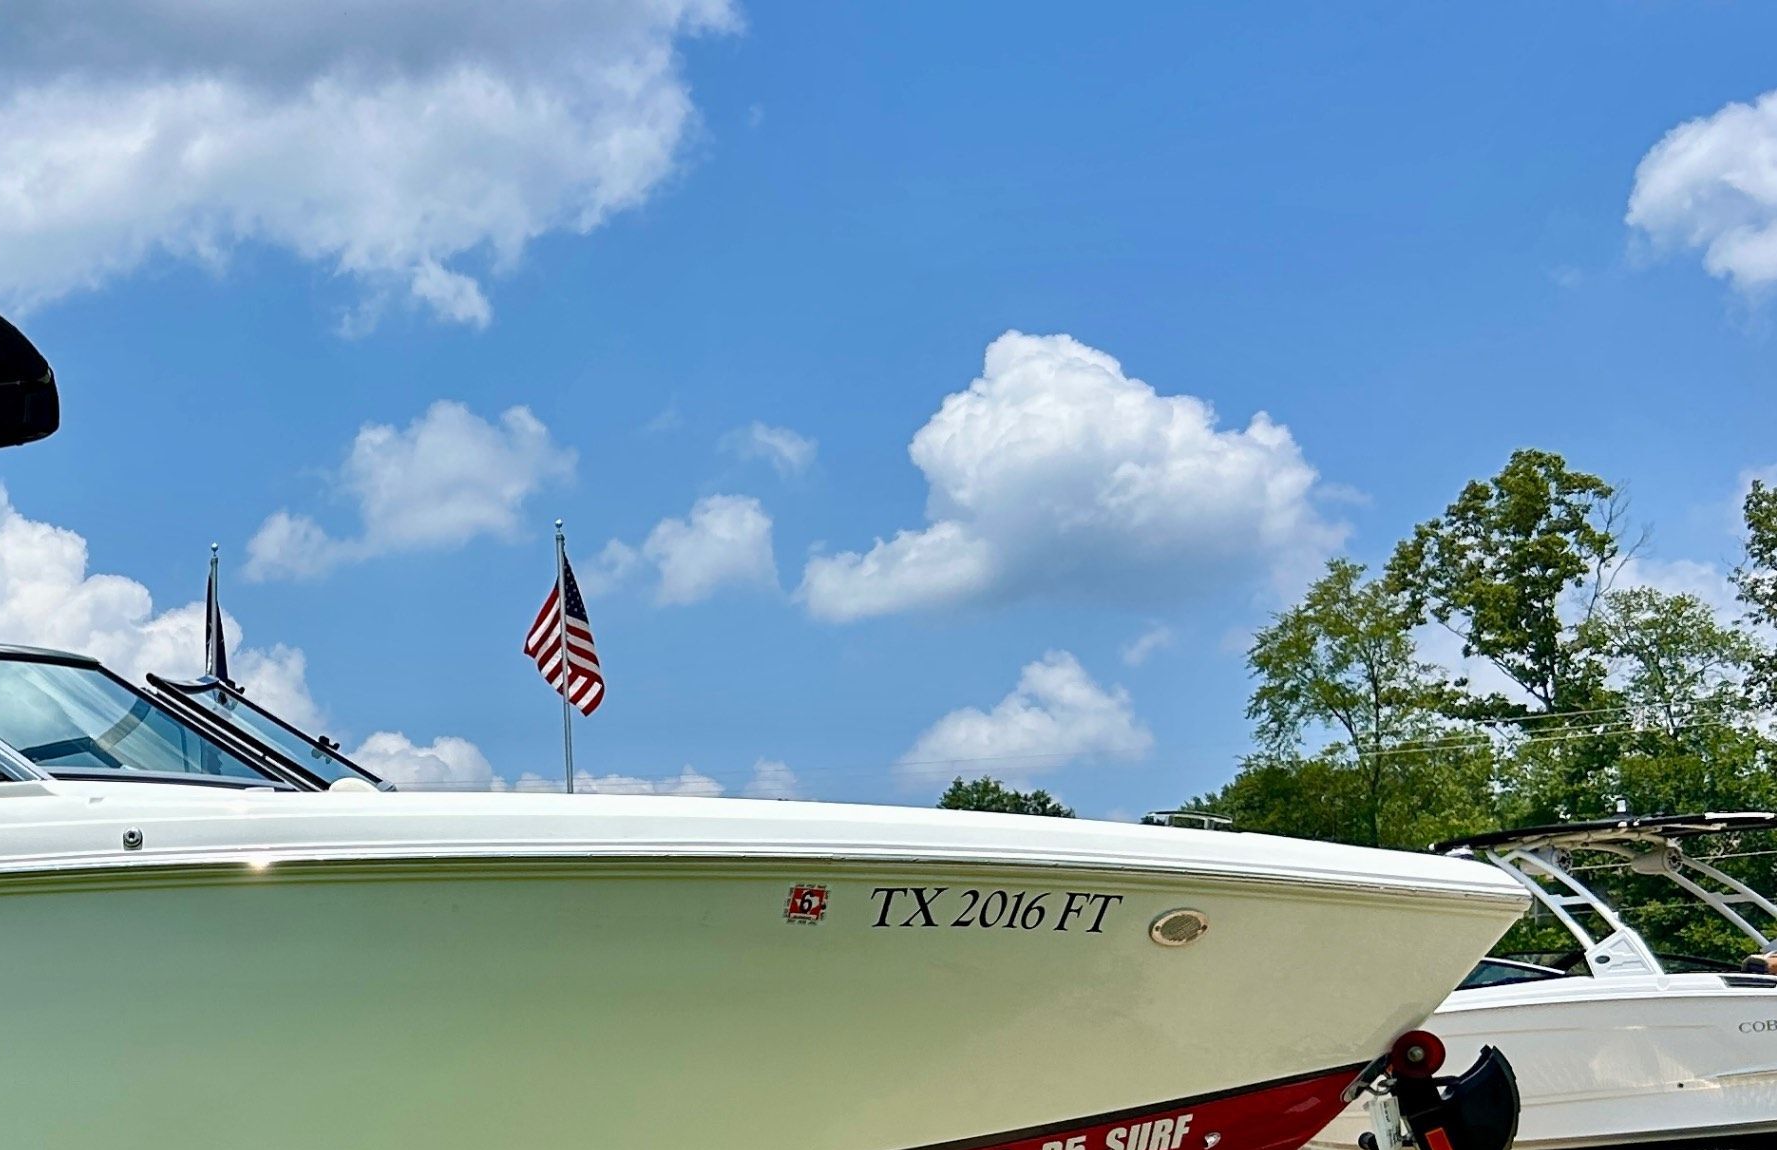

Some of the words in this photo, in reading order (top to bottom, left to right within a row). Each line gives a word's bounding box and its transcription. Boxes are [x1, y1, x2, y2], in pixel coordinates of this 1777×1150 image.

[800, 890, 815, 914] 6
[871, 887, 949, 927] TX
[951, 889, 1052, 931] 2016
[1053, 892, 1124, 934] FT
